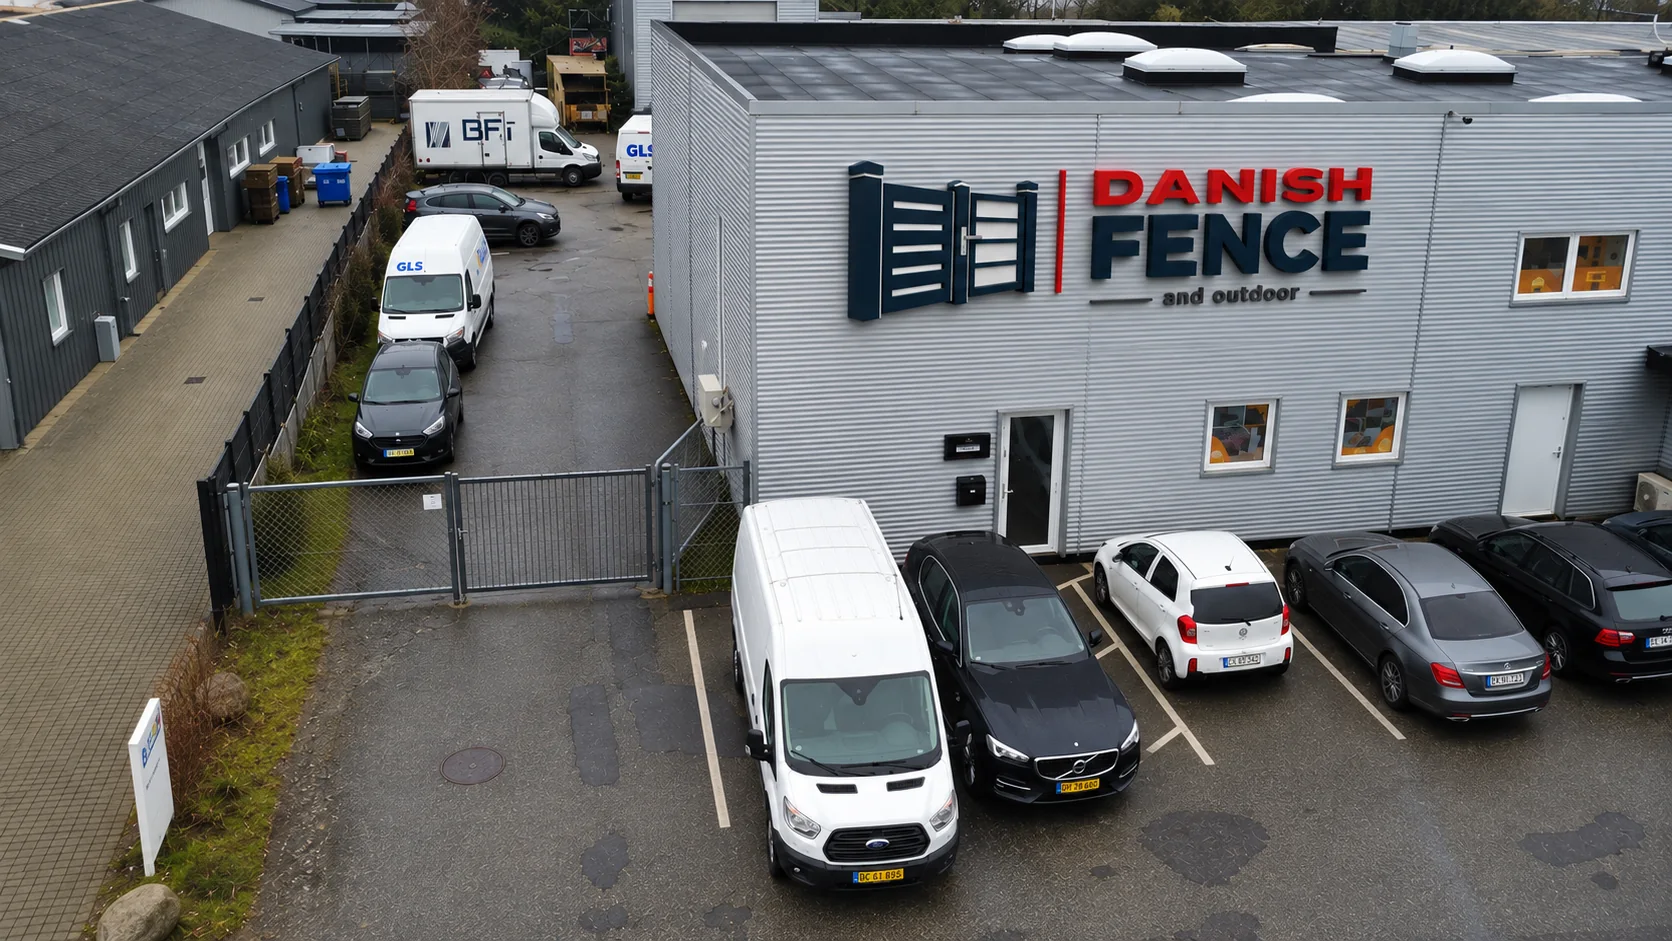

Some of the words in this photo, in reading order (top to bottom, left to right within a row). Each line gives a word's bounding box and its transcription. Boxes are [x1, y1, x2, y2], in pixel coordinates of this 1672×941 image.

[1093, 167, 1373, 207] DANISH
[1090, 210, 1371, 280] FENCE
[396, 261, 423, 272] GLS
[1162, 287, 1205, 306] and
[1212, 285, 1300, 304] outdoor
